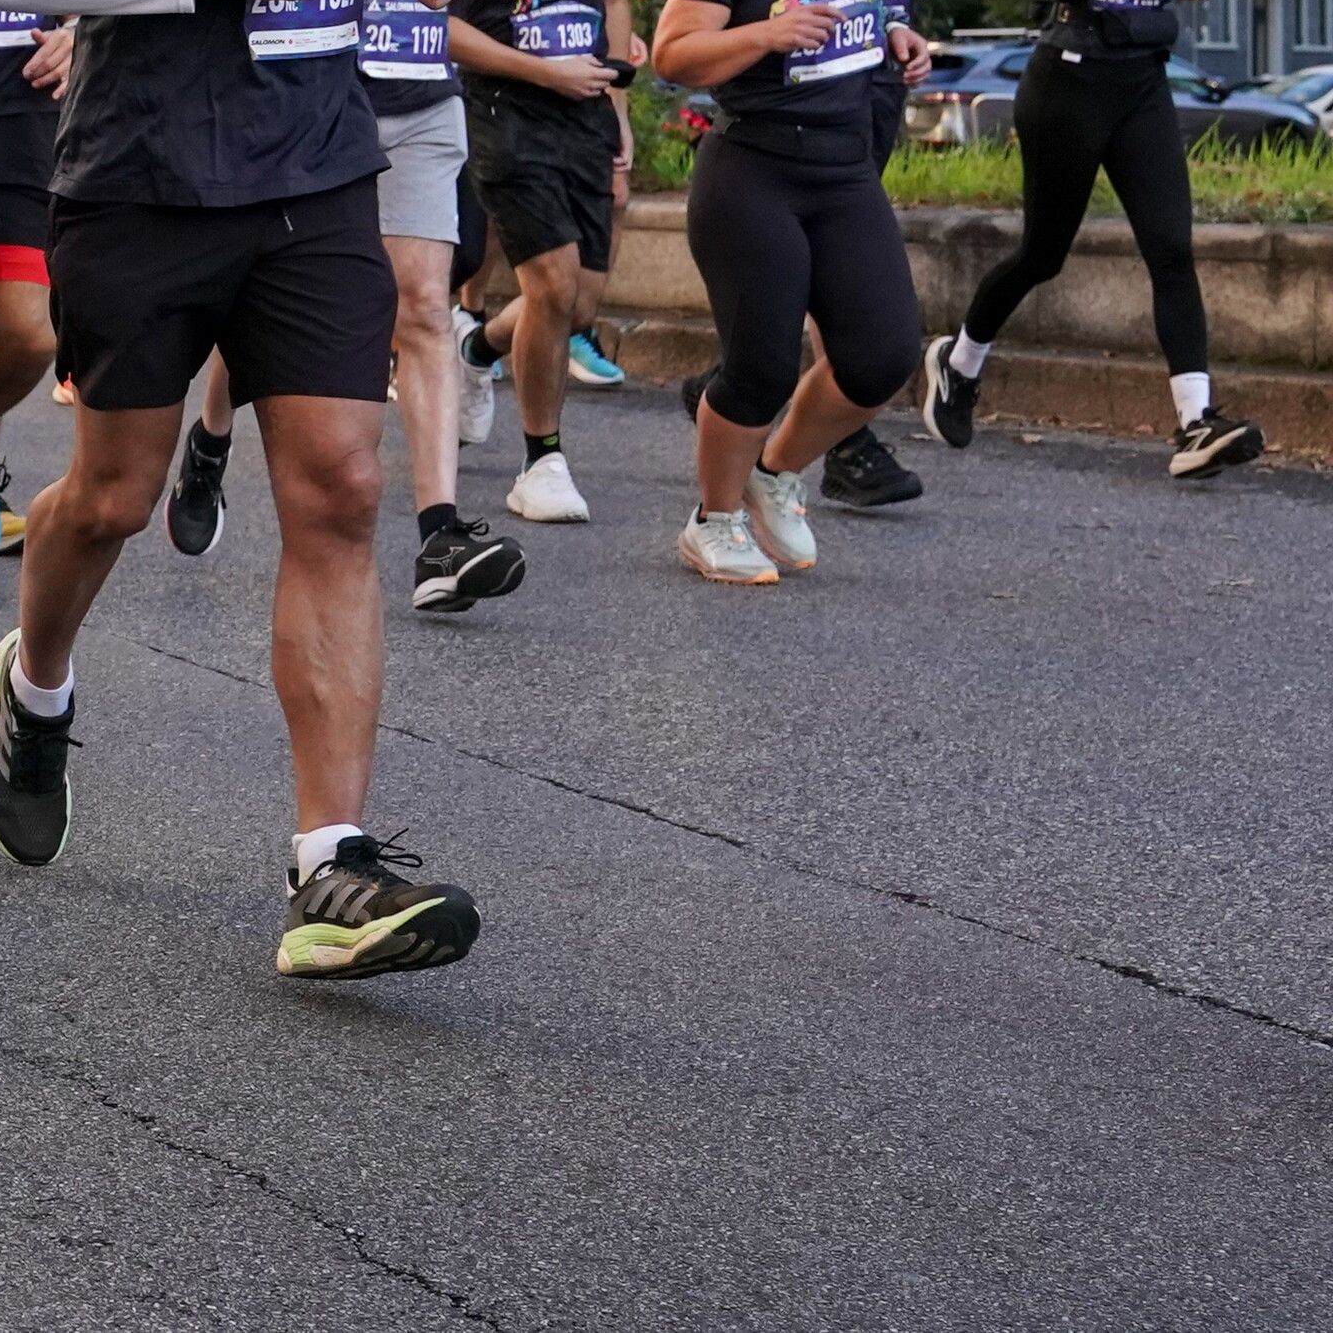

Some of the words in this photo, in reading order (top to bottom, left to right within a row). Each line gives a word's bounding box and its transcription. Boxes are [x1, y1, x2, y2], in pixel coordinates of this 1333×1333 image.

[251, 38, 286, 46] SALOMON
[411, 25, 444, 55] 1191
[557, 22, 593, 49] 1303
[835, 12, 876, 50] 1302
